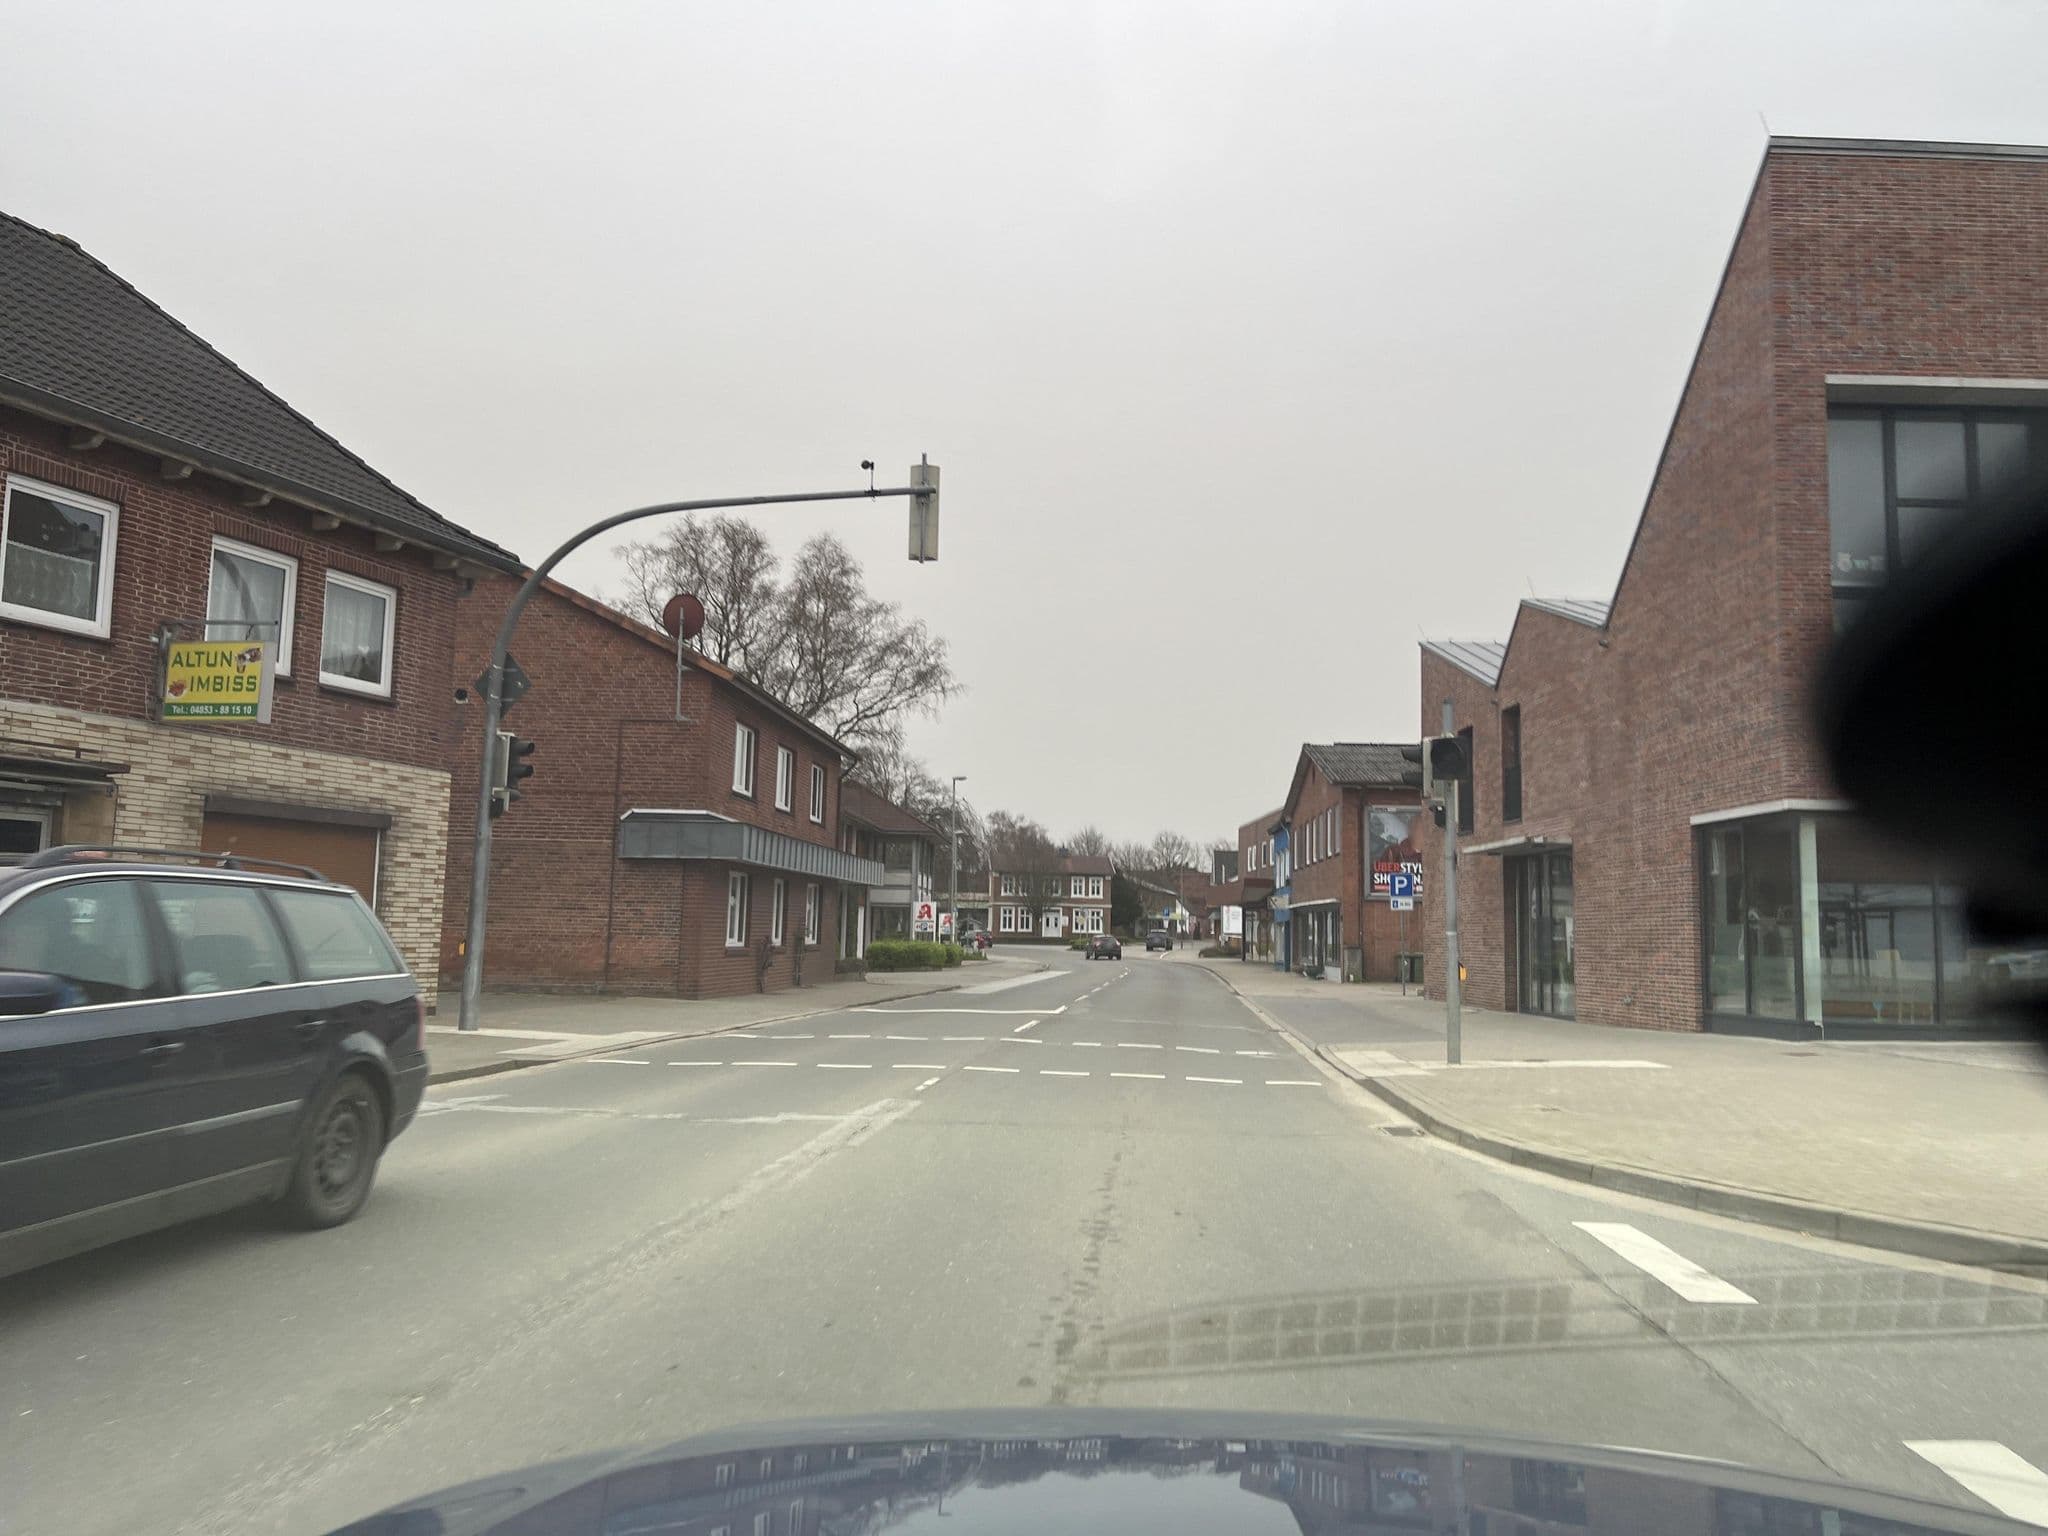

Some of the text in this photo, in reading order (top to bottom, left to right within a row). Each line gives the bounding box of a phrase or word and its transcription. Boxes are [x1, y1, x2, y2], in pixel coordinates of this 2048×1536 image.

[171, 650, 233, 668] ALTUN
[189, 675, 257, 692] IMBISS
[172, 705, 188, 714] Tel.:
[190, 705, 213, 714] 04853
[232, 705, 241, 714] 15
[243, 705, 252, 714] 10
[1395, 876, 1408, 895] P
